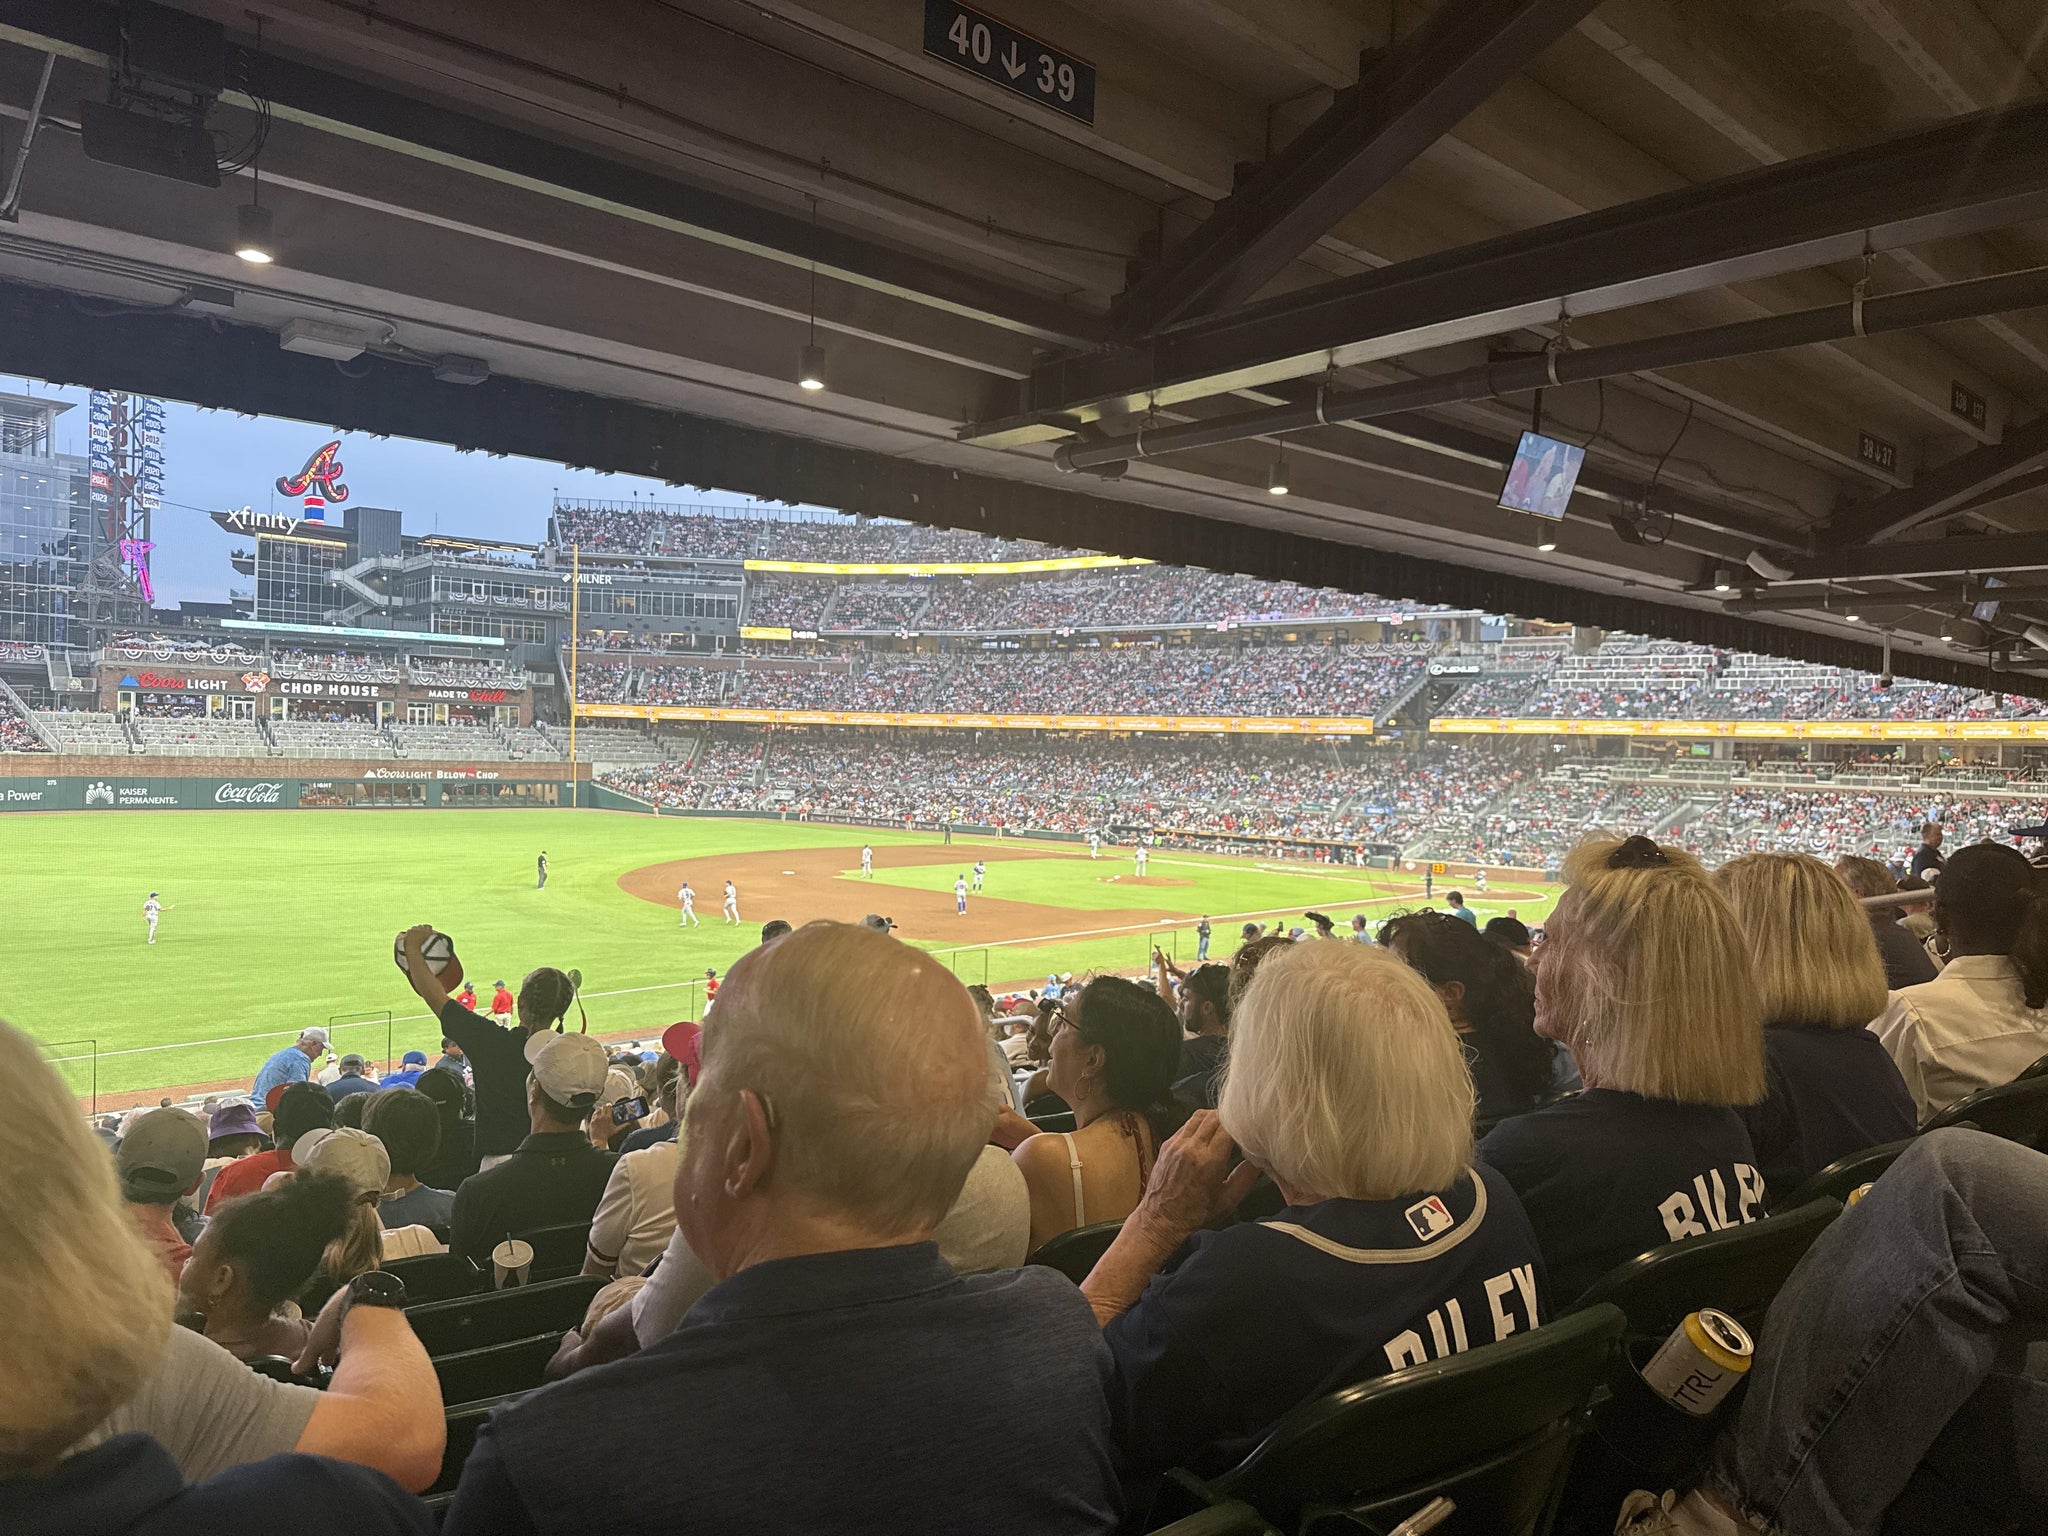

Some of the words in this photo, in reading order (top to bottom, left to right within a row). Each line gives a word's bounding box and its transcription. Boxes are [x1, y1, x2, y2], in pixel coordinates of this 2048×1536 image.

[948, 13, 992, 65] 40
[1036, 54, 1076, 103] 39
[93, 427, 108, 436] 2010
[145, 435, 160, 443] 2012
[92, 444, 108, 453] 2013
[276, 440, 349, 503] A
[91, 475, 107, 484] 2021
[144, 481, 160, 490] 2022
[91, 492, 108, 502] 2023
[226, 505, 300, 535] xfinity
[573, 573, 613, 585] MILNER
[139, 672, 186, 689] Coors
[187, 679, 228, 690] LIGHT
[280, 682, 324, 695] CHOP
[328, 684, 380, 697] HOUSE
[428, 689, 455, 699] MADE
[457, 690, 469, 699] TO
[469, 689, 507, 702] Chill
[376, 767, 405, 779] Coors
[406, 771, 432, 779] LIGHT
[7, 790, 42, 801] Power
[119, 788, 148, 796] KAISER
[214, 782, 284, 803] Coca-Cola
[119, 797, 176, 805] PERMANENTE
